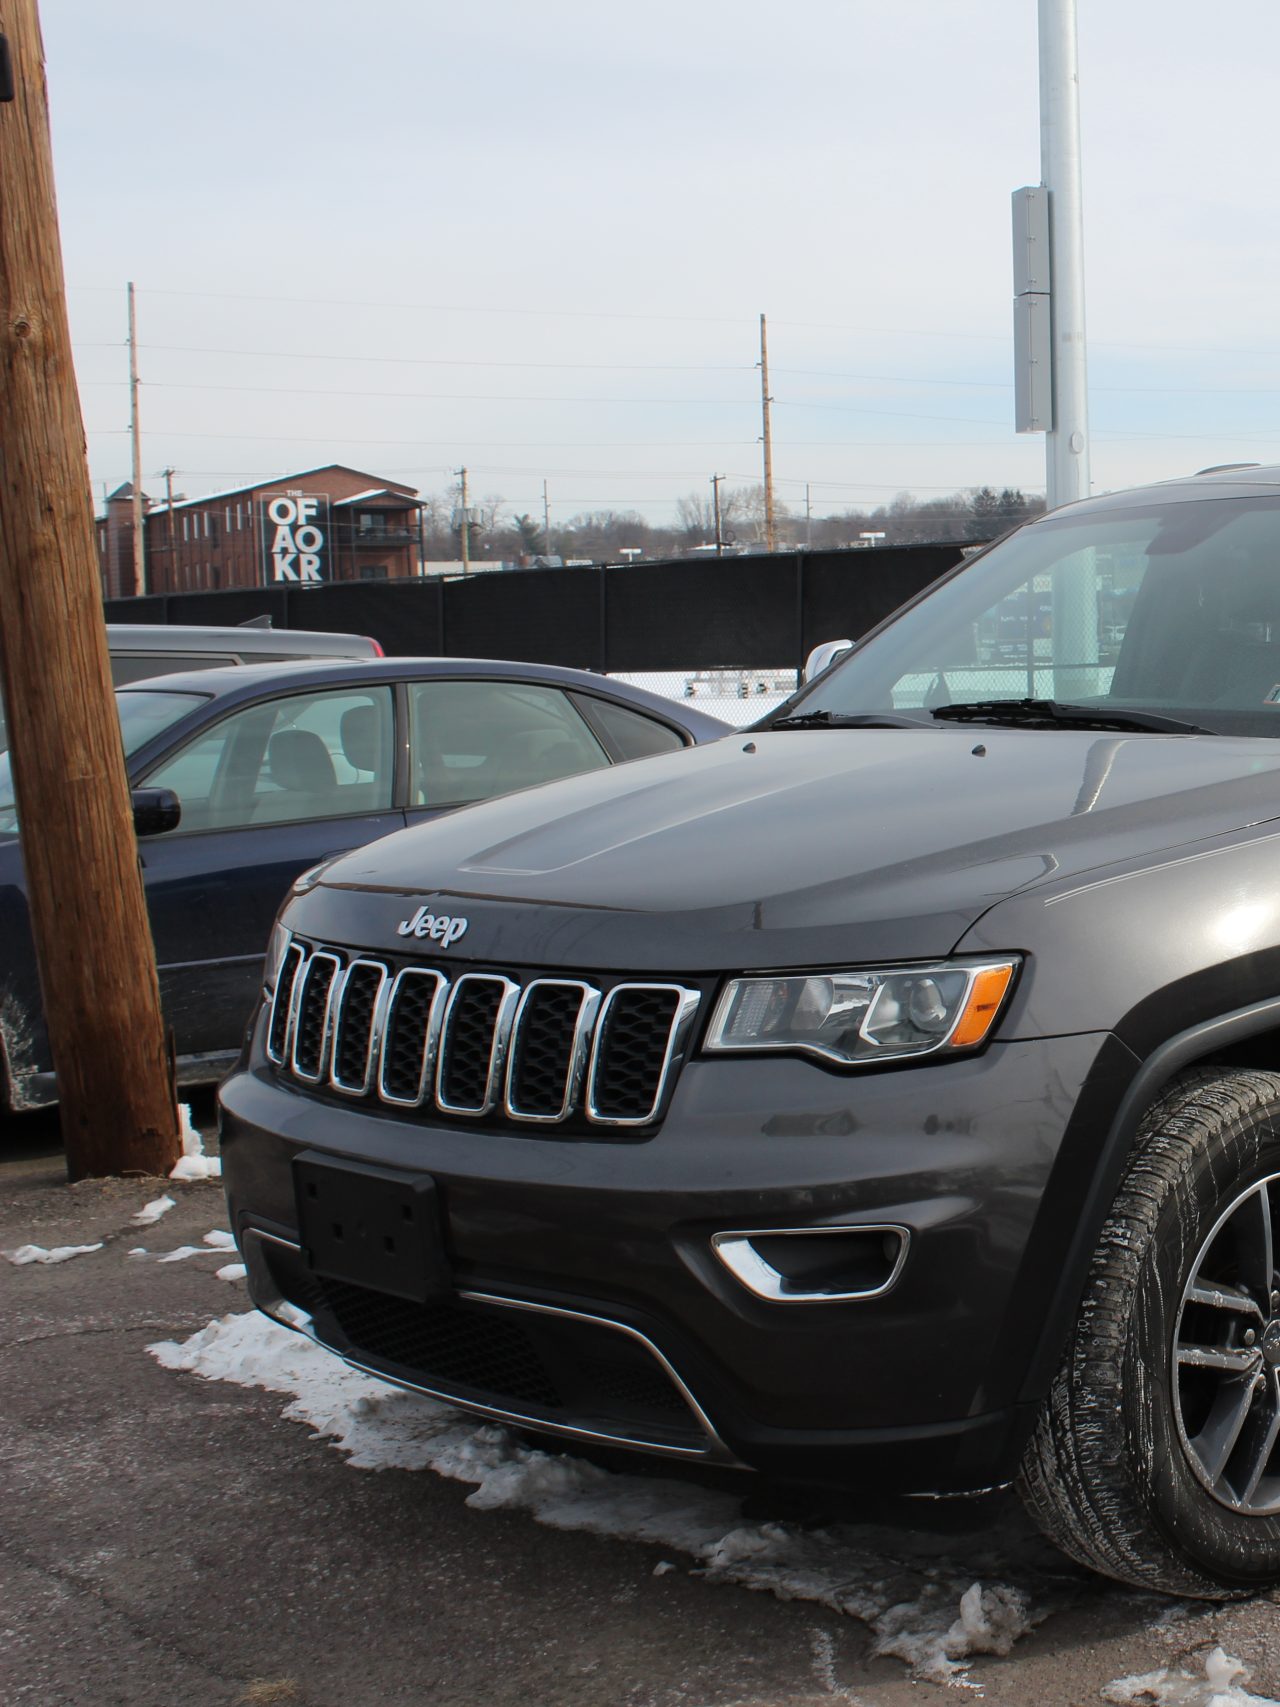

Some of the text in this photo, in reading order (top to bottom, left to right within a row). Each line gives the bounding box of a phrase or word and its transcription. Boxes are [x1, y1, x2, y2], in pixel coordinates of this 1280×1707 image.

[268, 497, 319, 526] OF
[271, 525, 324, 554] AO
[273, 553, 323, 581] KR
[397, 905, 468, 949] Jeep
